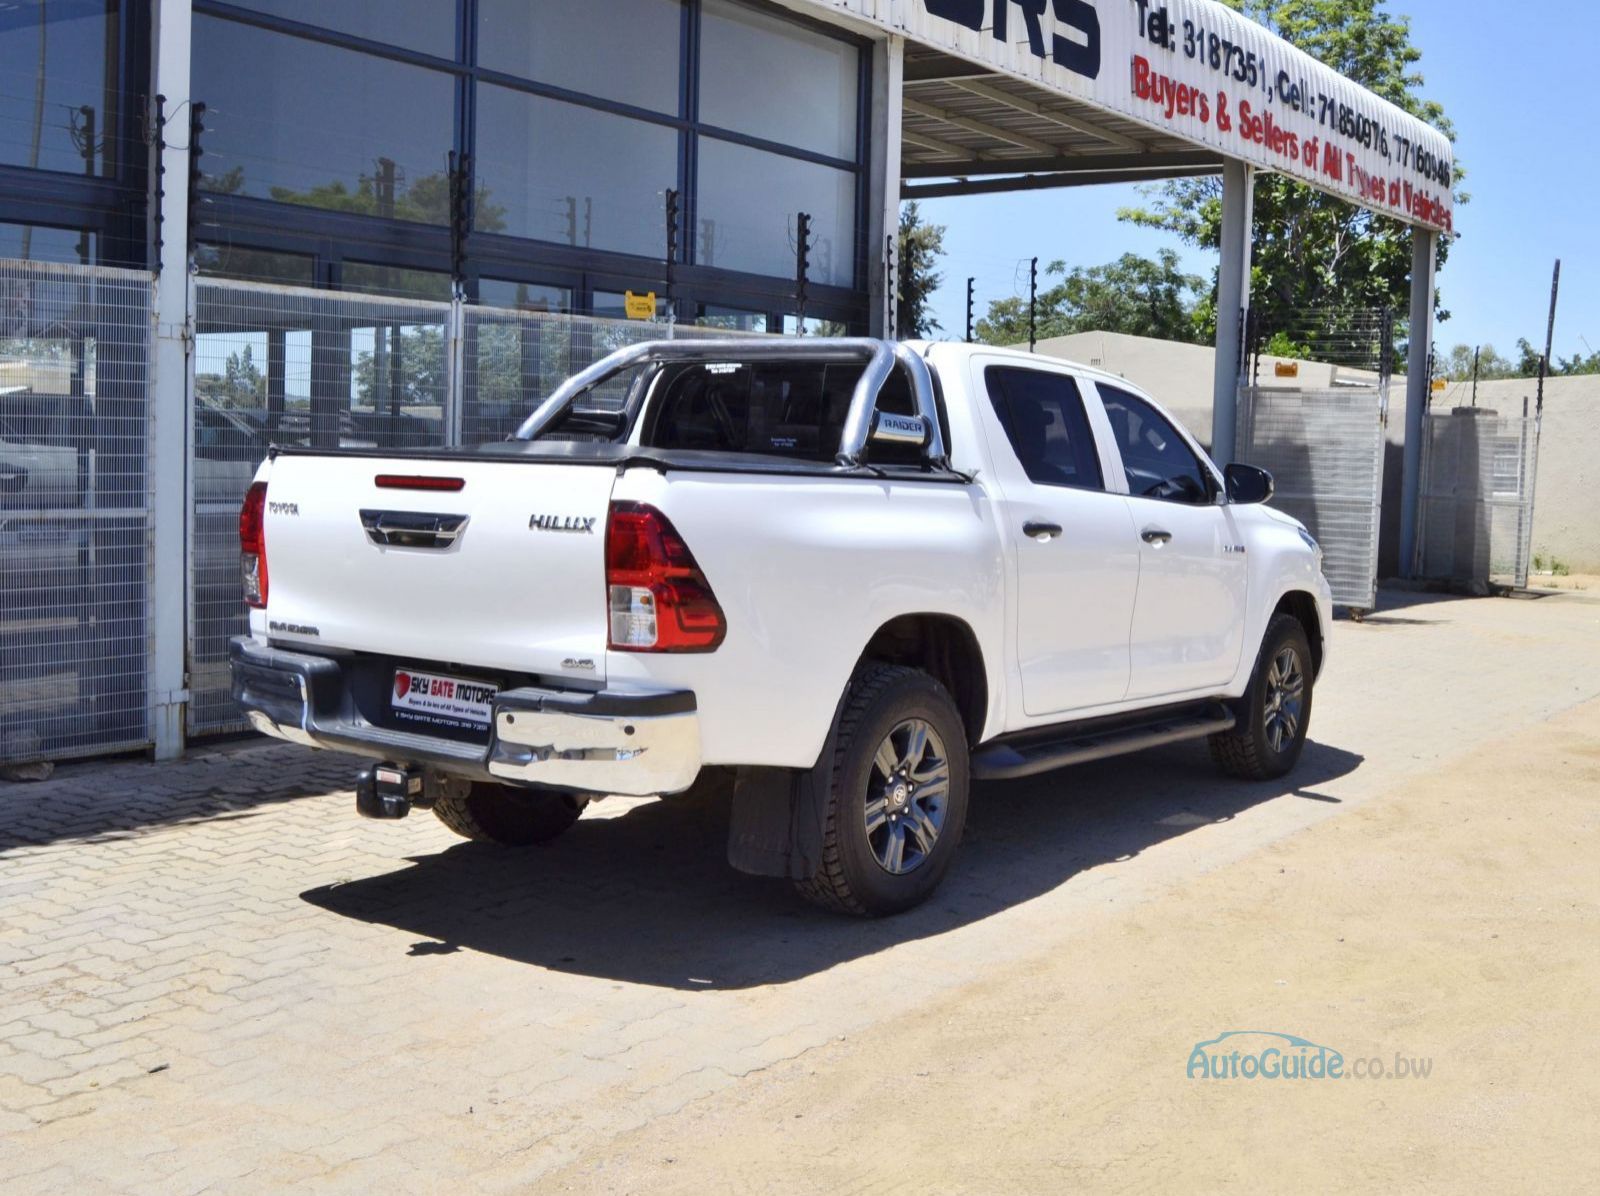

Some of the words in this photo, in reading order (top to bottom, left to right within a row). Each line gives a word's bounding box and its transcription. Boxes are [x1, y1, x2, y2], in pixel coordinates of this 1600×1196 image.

[1133, 0, 1175, 52] Tel:
[1132, 54, 1210, 123] Buyers
[1216, 91, 1232, 132] &
[1239, 100, 1299, 160] Sellers
[1302, 136, 1319, 171] of
[1324, 141, 1342, 181] All
[1346, 152, 1386, 202] Types
[1403, 179, 1452, 232] Vehicles
[885, 419, 922, 432] RAIDER
[269, 502, 300, 516] TOYOTA
[528, 514, 596, 534] HILUX
[410, 677, 429, 695] SKY
[431, 679, 455, 698] GATE
[456, 683, 496, 705] MOTORS
